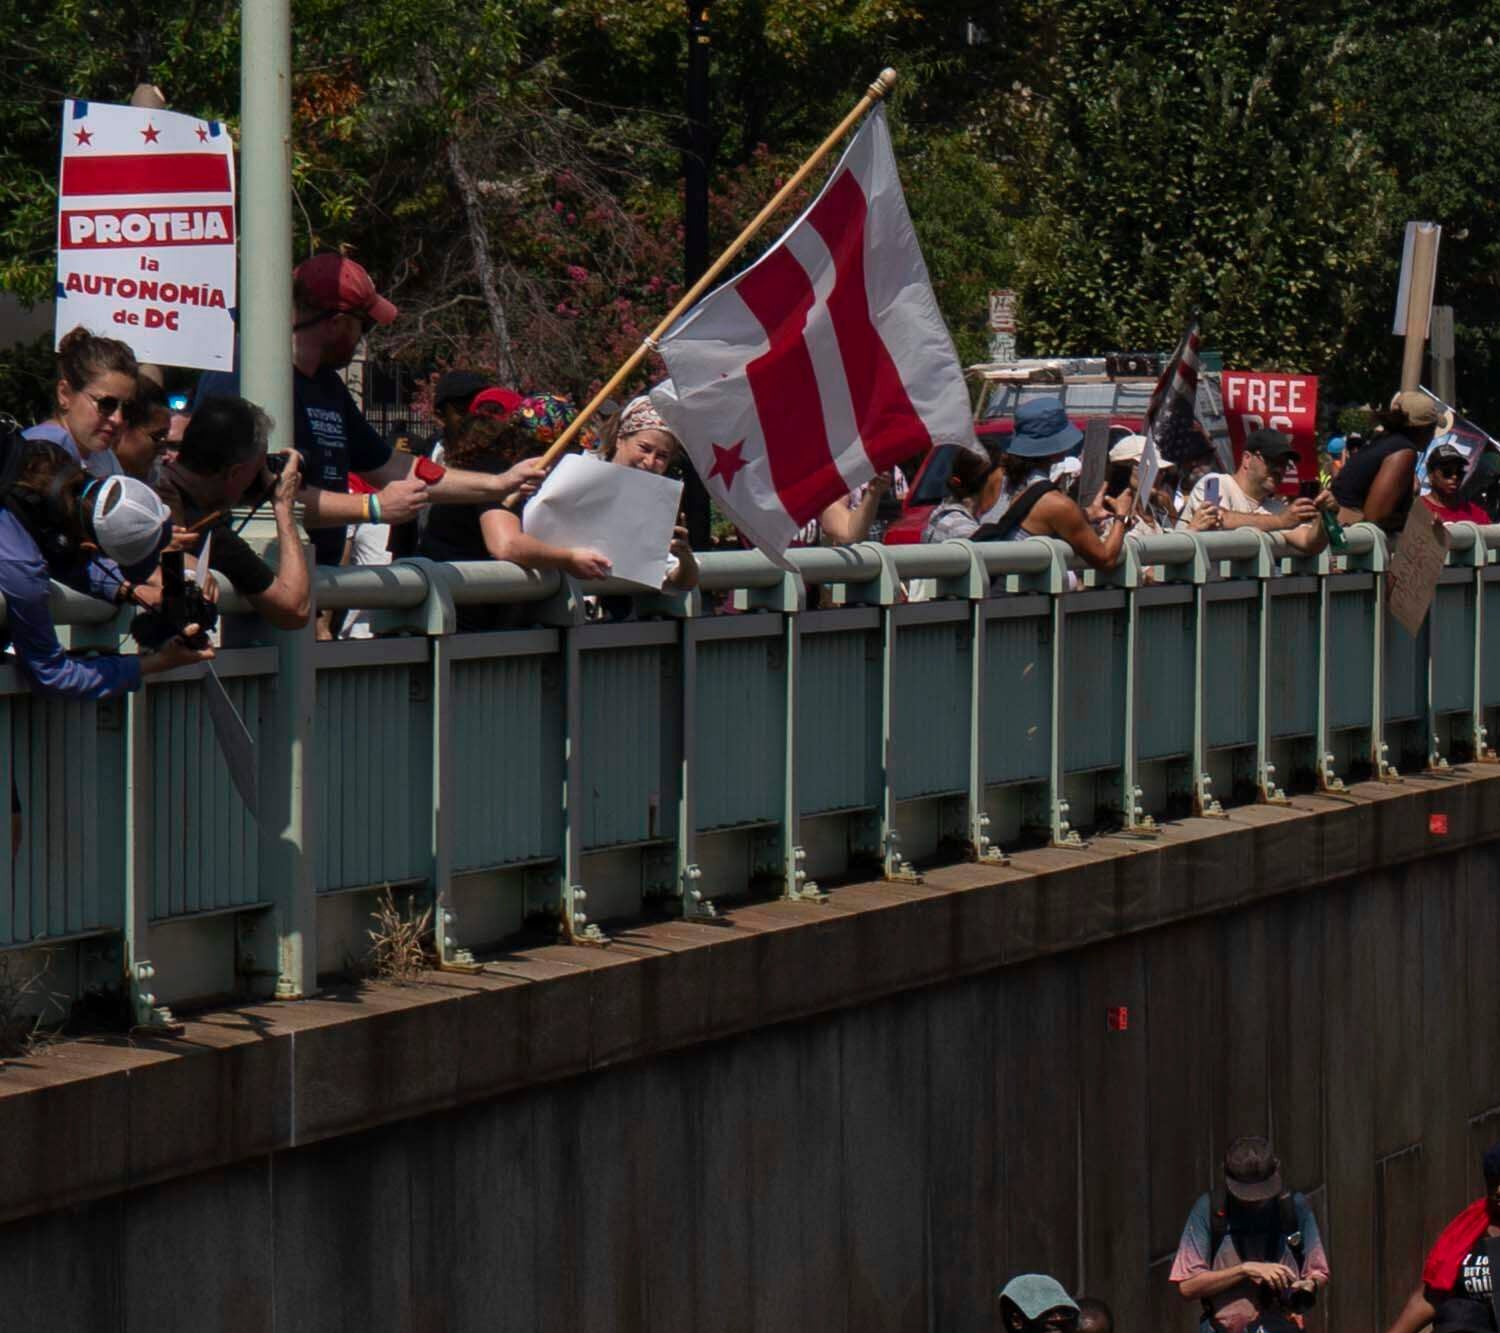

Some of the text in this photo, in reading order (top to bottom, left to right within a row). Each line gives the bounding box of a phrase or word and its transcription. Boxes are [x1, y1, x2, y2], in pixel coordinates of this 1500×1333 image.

[69, 213, 229, 246] PROTEJA
[141, 257, 160, 272] la
[66, 274, 226, 308] AUTONOMÍA
[113, 310, 181, 332] de DC
